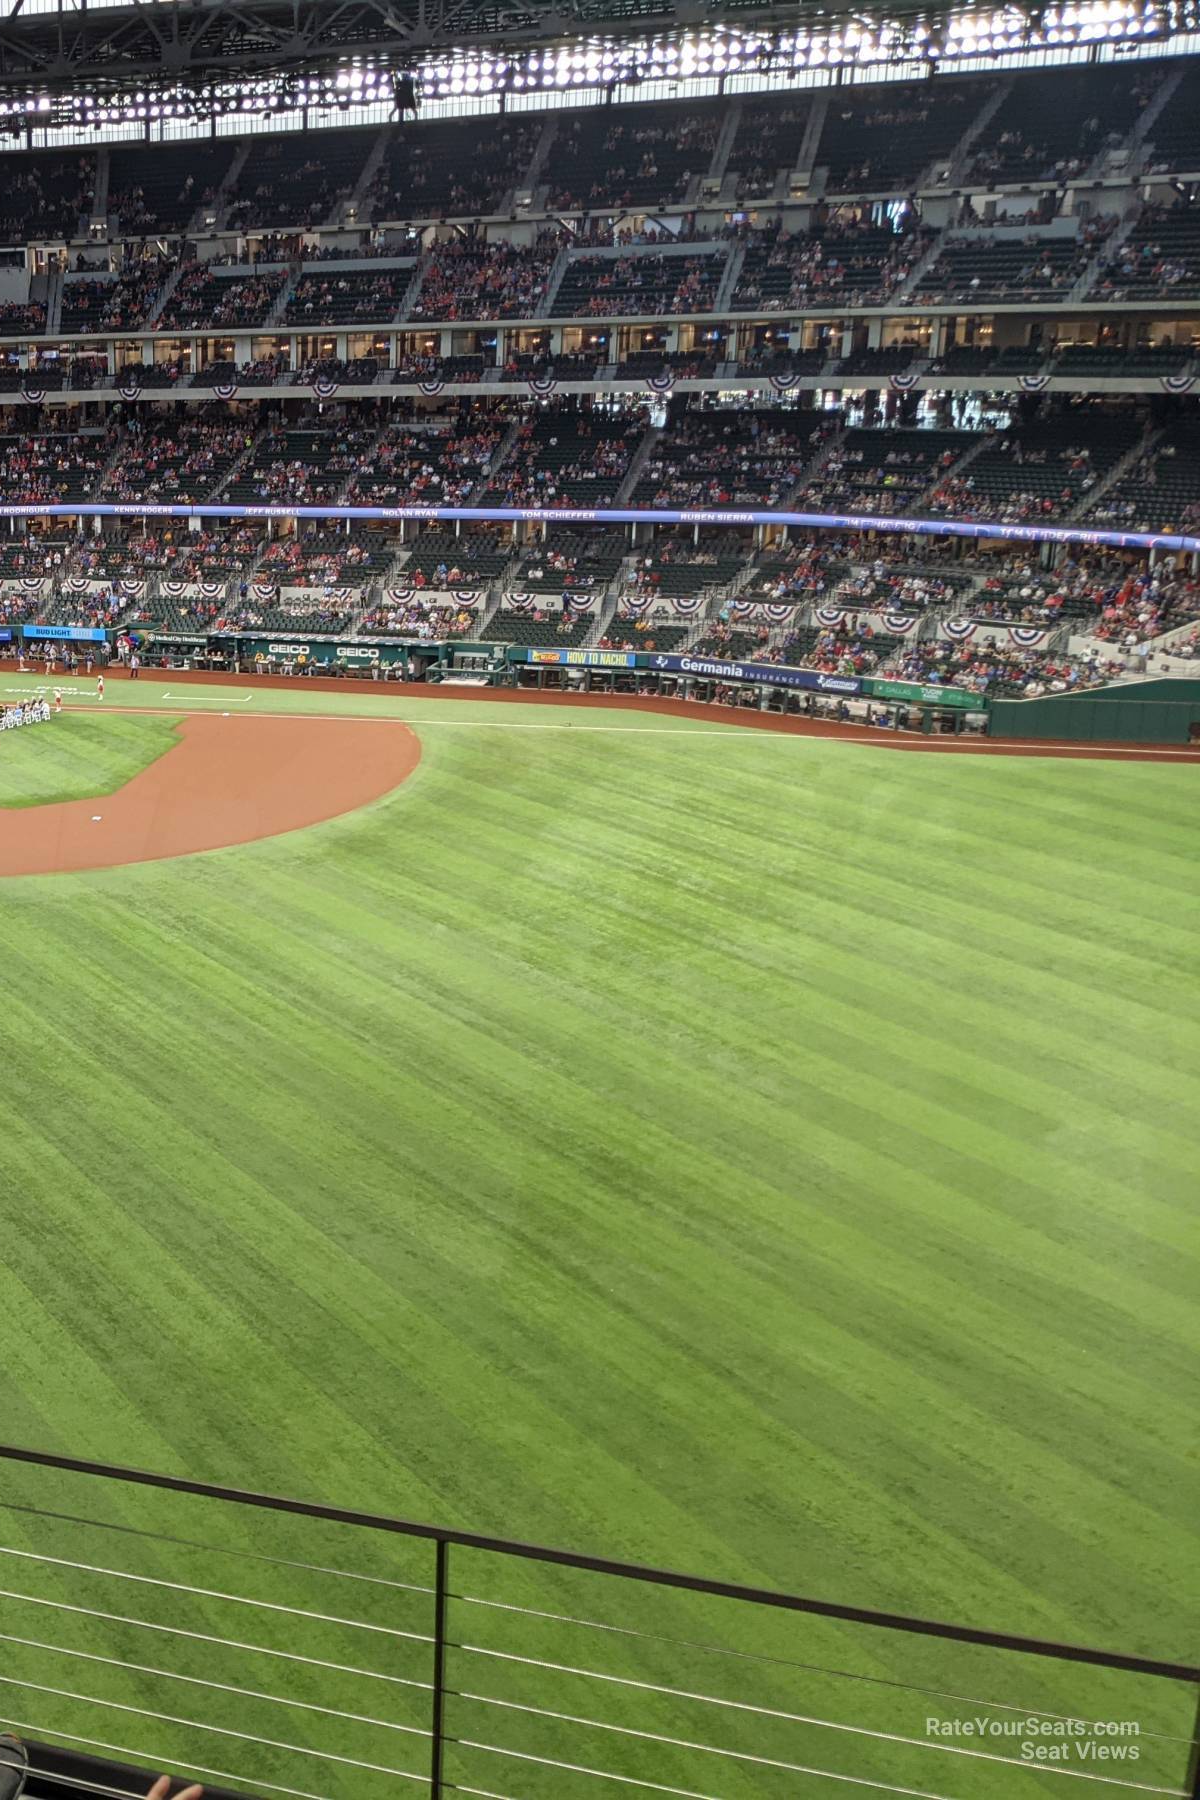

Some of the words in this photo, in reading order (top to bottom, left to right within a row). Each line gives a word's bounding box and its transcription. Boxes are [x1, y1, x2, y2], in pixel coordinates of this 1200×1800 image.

[382, 509, 412, 517] NOLAN
[717, 514, 754, 522] SIERRA
[36, 628, 49, 636] BUD
[50, 629, 70, 637] LIGHT
[268, 644, 309, 655] GEICO
[337, 647, 379, 658] GEICO
[567, 651, 587, 665] HOW
[588, 652, 598, 665] TO
[600, 653, 627, 666] NACHO.
[680, 658, 743, 677] Germania
[744, 672, 800, 684] INSURANCE
